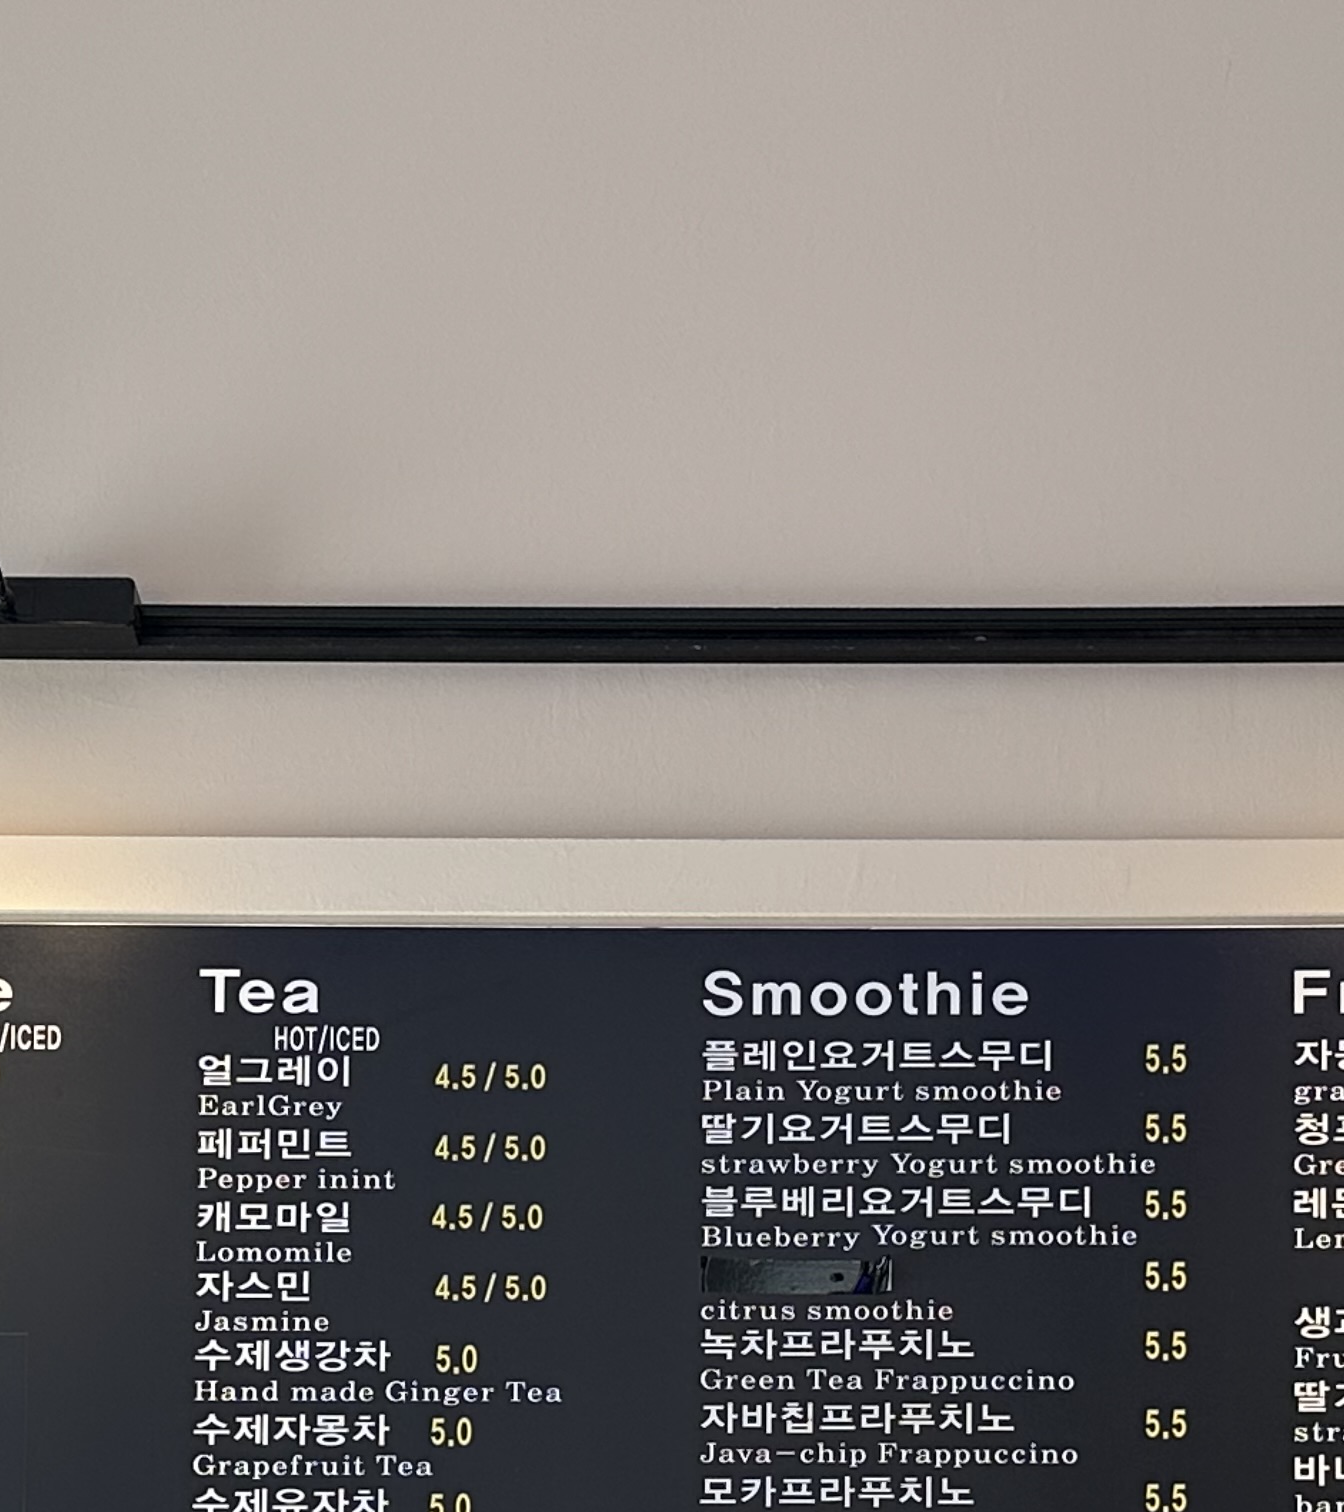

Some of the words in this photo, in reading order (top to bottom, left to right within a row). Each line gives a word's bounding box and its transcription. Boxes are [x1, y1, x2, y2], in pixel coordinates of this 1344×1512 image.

[198, 968, 319, 1015] Tea
[702, 970, 1029, 1017] Smoothie
[274, 1024, 380, 1055] HOT/ICED
[701, 1039, 1052, 1072] 플레인요거트스무디
[198, 1053, 350, 1088] 얼그레이
[1145, 1043, 1187, 1075] 5.5
[197, 1094, 343, 1121] EarlGrey
[702, 1079, 786, 1102] Plain
[795, 1079, 904, 1105] Yogurt
[915, 1079, 1062, 1102] smoothie
[197, 1127, 352, 1161] 페퍼민트
[701, 1112, 1010, 1145] 딸기요거트스무디
[197, 1167, 307, 1194] Pepper
[317, 1167, 396, 1190] inint
[196, 1200, 350, 1234] 캐모마일
[701, 1185, 1091, 1219] 블루베리요거트스무디
[196, 1240, 352, 1263] Lomomile
[701, 1225, 861, 1252] Blueberry
[871, 1223, 980, 1250] Yogurt
[991, 1224, 1138, 1246] smoothie
[195, 1269, 310, 1303] 자스민
[194, 1309, 329, 1332] Jasmine
[194, 1338, 392, 1373] 수제생강차
[435, 1344, 478, 1375] 5.0
[700, 1328, 975, 1361] 녹차프라푸치노
[194, 1379, 279, 1402] Hand
[290, 1380, 374, 1403] made
[384, 1379, 495, 1407] Ginger
[505, 1381, 563, 1403] Tea
[192, 1412, 391, 1447] 수제자몽차
[700, 1401, 1015, 1435] 자바칩프라푸치노
[192, 1453, 366, 1480] Grapefruit
[375, 1454, 434, 1477] Tea
[877, 1441, 1079, 1469] Frappuccino
[699, 1475, 975, 1509] 모카프라푸치노
